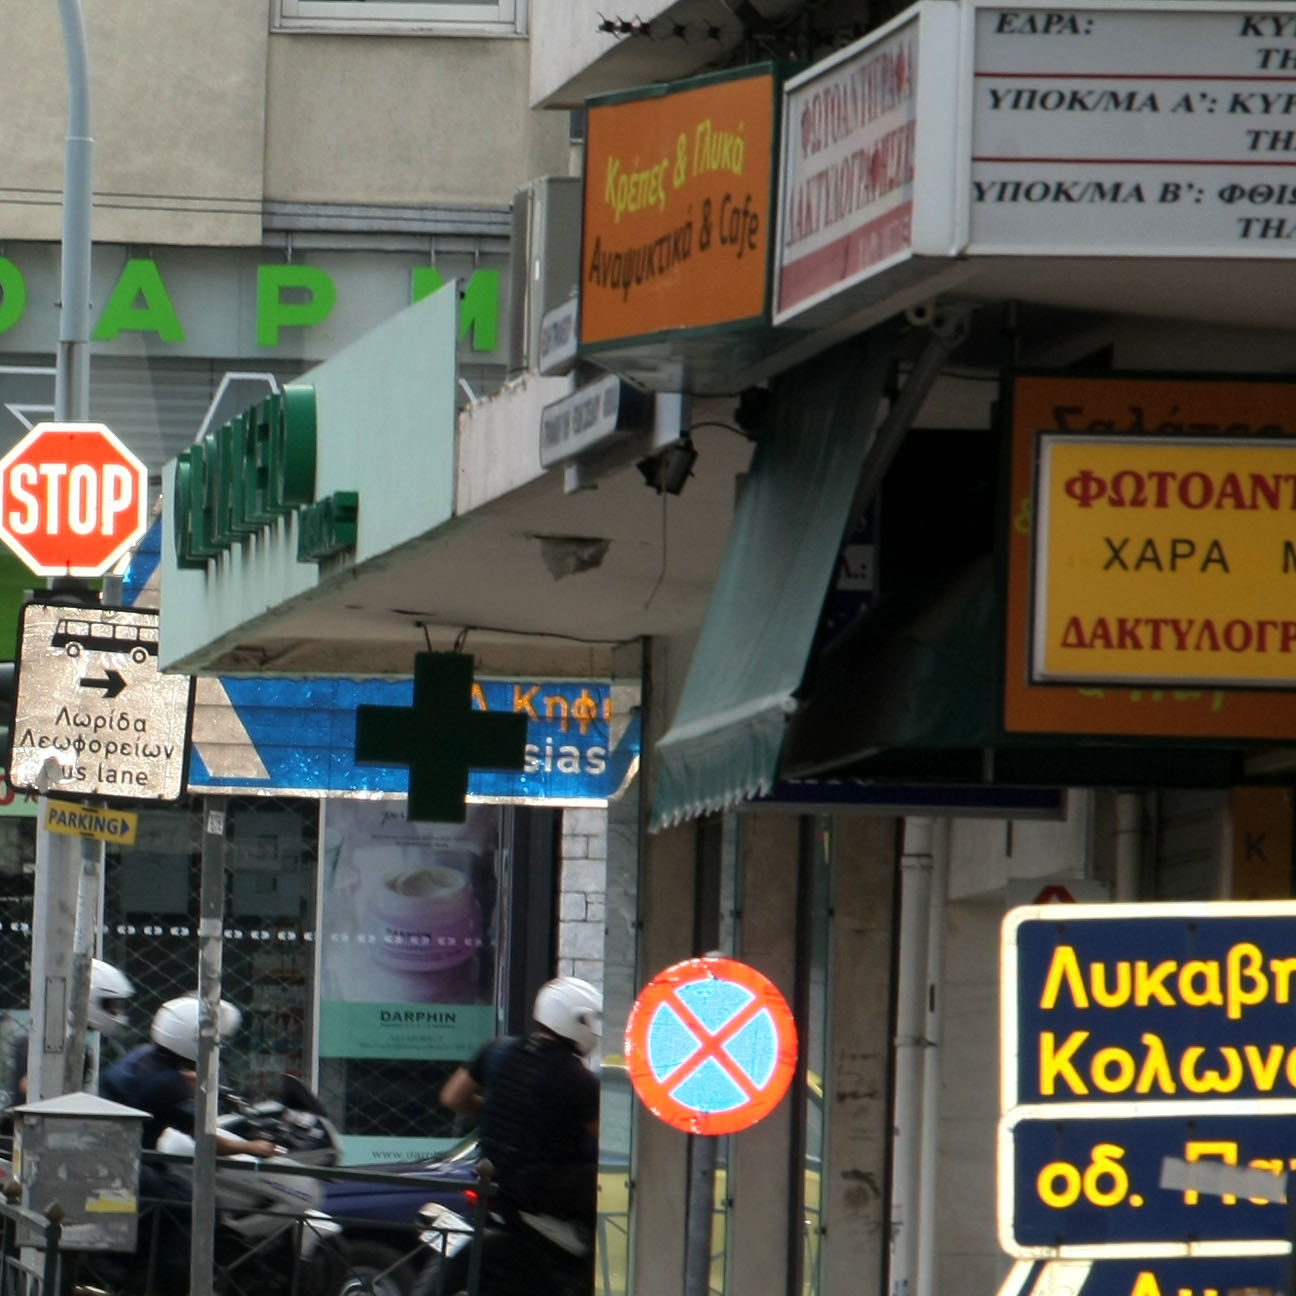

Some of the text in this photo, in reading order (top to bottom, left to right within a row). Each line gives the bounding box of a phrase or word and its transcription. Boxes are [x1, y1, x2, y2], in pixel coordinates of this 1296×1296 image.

[995, 13, 1296, 37] ΕΔΡΑ: ΚΥ
[989, 88, 1159, 113] ΥΠΟΚ/ΜΑ
[605, 155, 669, 224] Κρέπες
[674, 132, 689, 189] &
[972, 181, 1145, 204] ΥΠΟΚ/ΜΑ
[1217, 184, 1296, 205] ΦΘΙ
[588, 193, 759, 303] Αναψυκτικά & Cafe
[10, 462, 133, 538] STOP
[1103, 537, 1230, 573] ΧΑΡΑ
[55, 706, 147, 734] Λωρίδα
[19, 728, 175, 760] Λεωφορείων
[98, 763, 148, 786] lane
[48, 807, 121, 836] PARKING
[379, 1010, 456, 1023] DARPHIN
[1040, 1031, 1296, 1095] Κολων
[1036, 1143, 1144, 1208] οδ.
